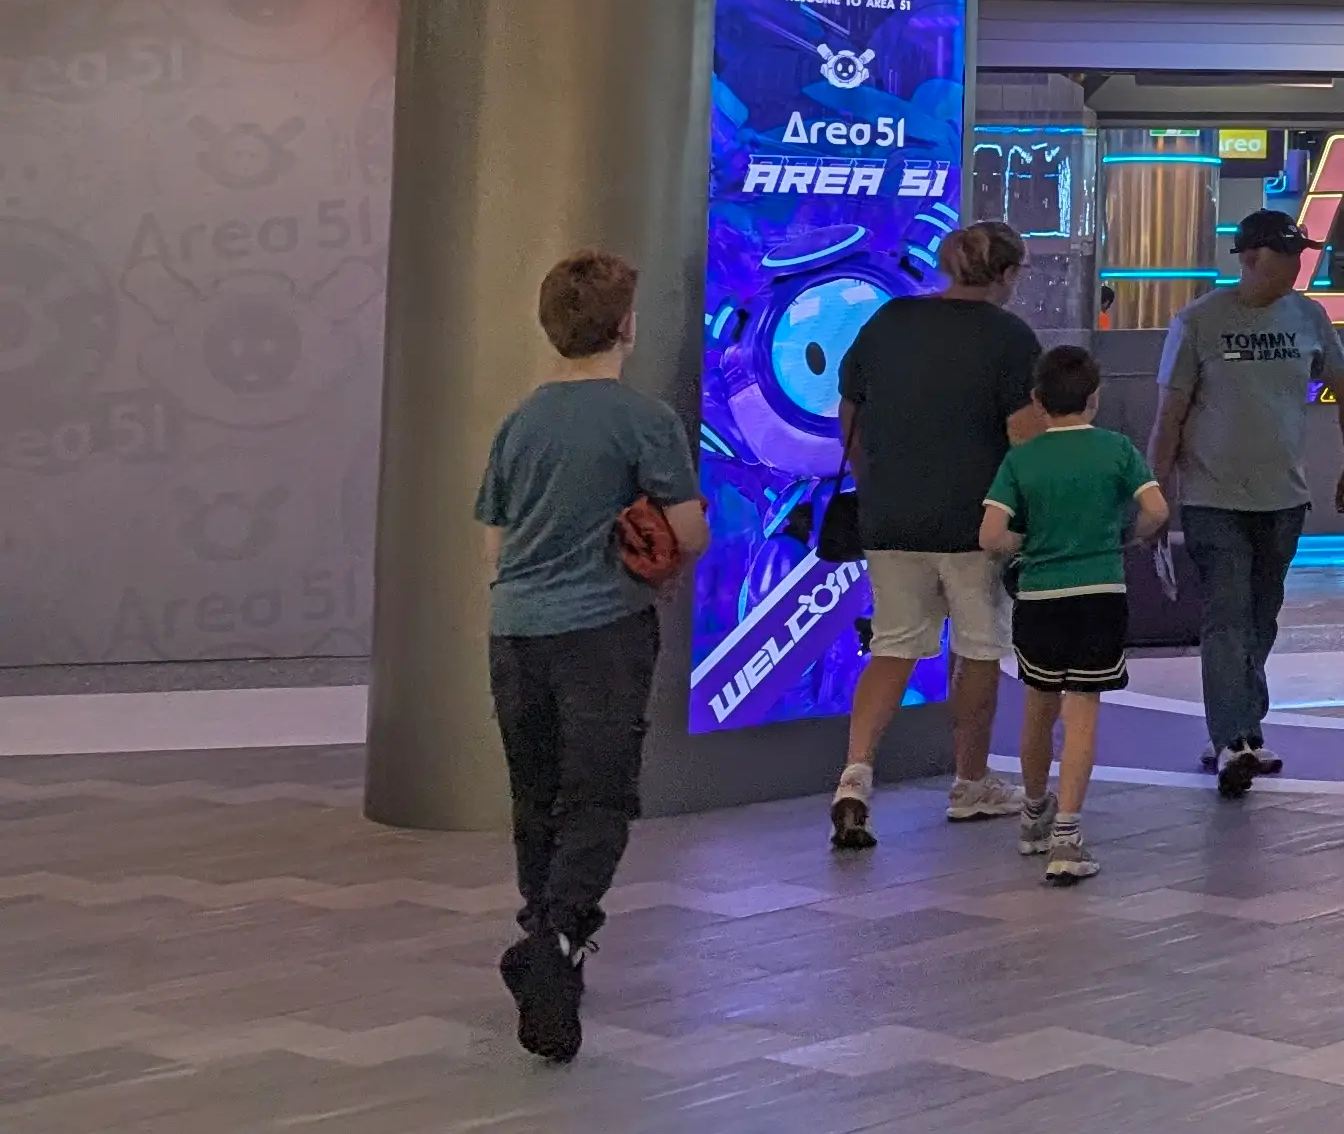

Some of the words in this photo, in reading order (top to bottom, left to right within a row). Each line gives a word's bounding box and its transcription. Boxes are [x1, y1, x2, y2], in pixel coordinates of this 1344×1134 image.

[782, 111, 871, 146] Area
[877, 118, 905, 148] 51
[742, 154, 887, 196] AREA
[896, 159, 951, 197] 51
[1221, 332, 1297, 349] TOMMY
[1256, 348, 1301, 361] JEANS
[708, 560, 868, 724] WELCOM
